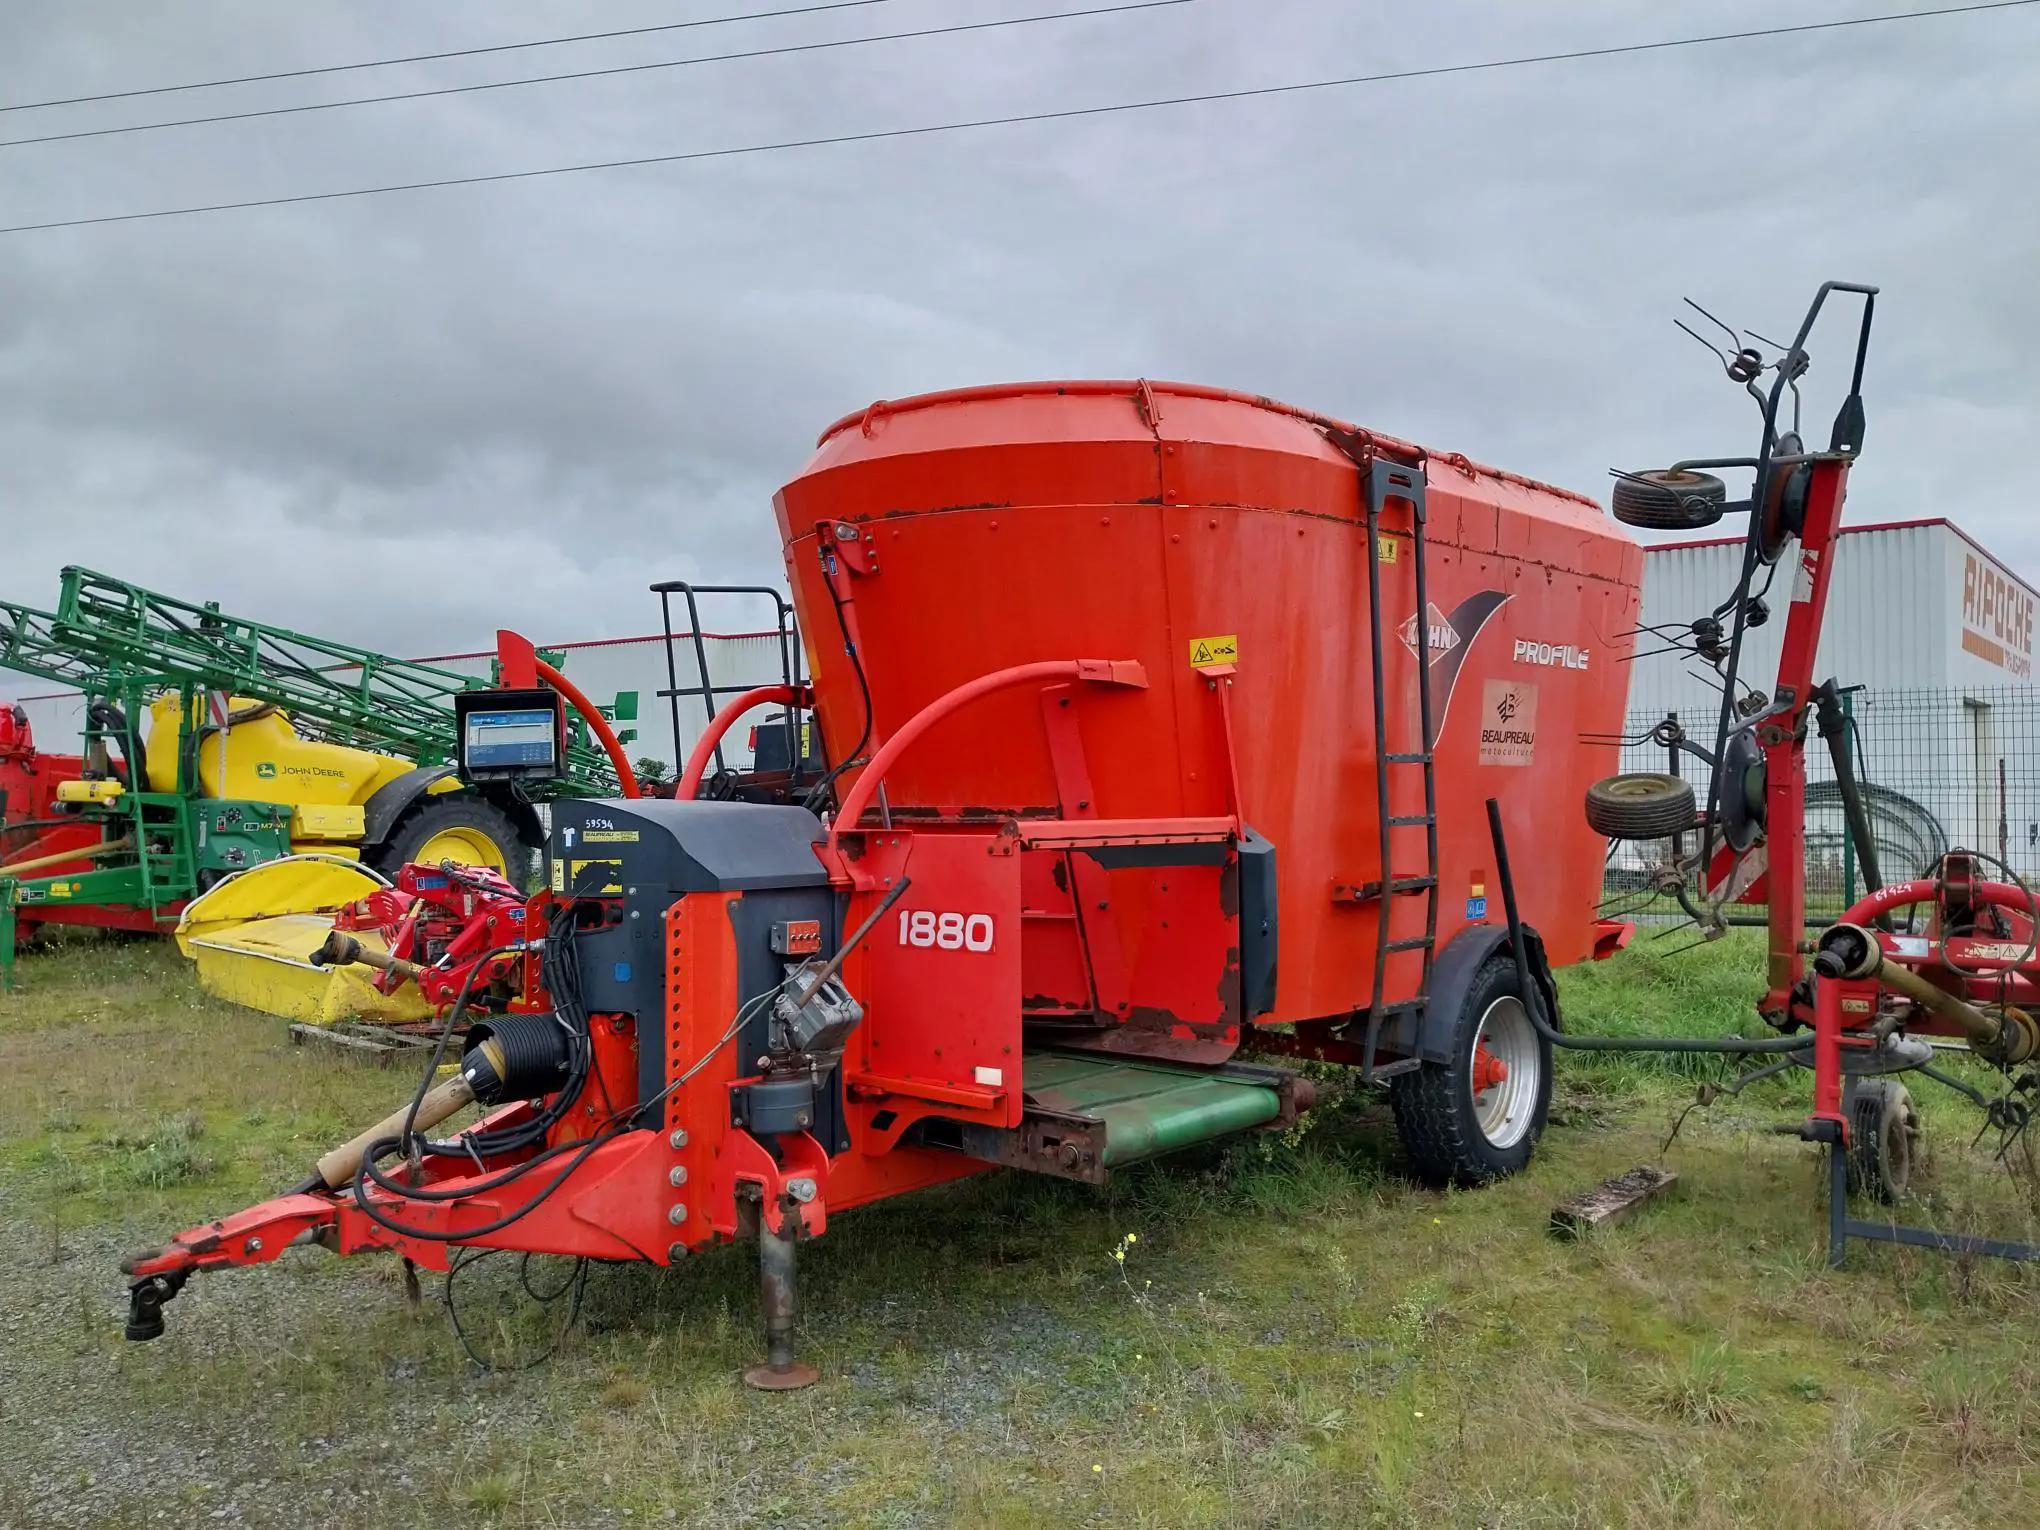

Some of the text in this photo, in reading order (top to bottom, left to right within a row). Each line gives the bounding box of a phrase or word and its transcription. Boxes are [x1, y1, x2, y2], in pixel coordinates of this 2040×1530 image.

[1406, 622, 1452, 650] KHN
[1481, 729, 1535, 745] BEAUPREAU
[1480, 747, 1534, 757] motoculture
[281, 765, 345, 778] JOHN DEERE
[899, 910, 994, 952] 1880
